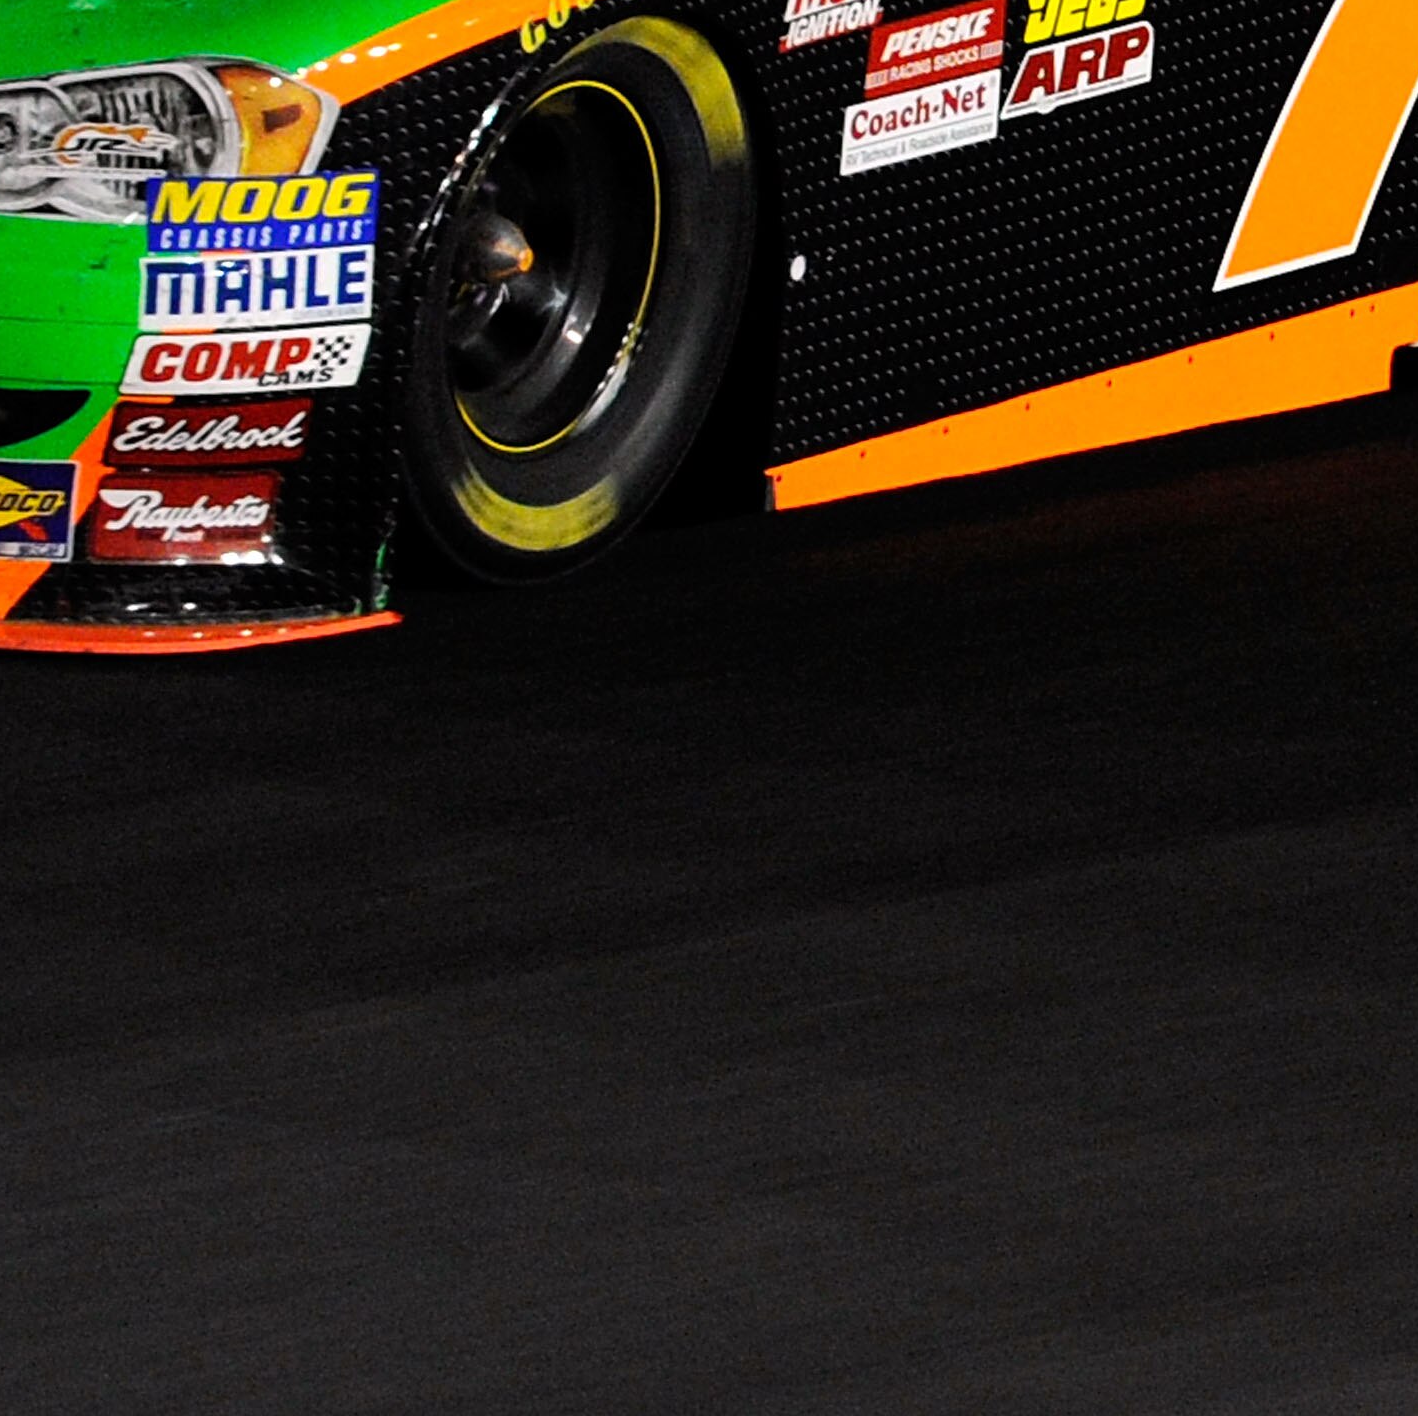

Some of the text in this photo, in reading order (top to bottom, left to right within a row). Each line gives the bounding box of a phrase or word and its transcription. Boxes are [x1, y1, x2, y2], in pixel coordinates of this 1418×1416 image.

[880, 8, 995, 63] PENSKE
[888, 46, 980, 81] RACING SHOCKS
[1010, 25, 1150, 104] ARP
[850, 83, 987, 141] Coach-Net
[151, 172, 376, 224] MOOG
[159, 219, 364, 249] CHASSIS PARTS
[144, 250, 367, 315] MAHLE
[140, 337, 312, 383] COMP
[257, 367, 335, 387] CAMS
[112, 410, 307, 452] Edelbrock
[99, 488, 271, 541] Raybestos
